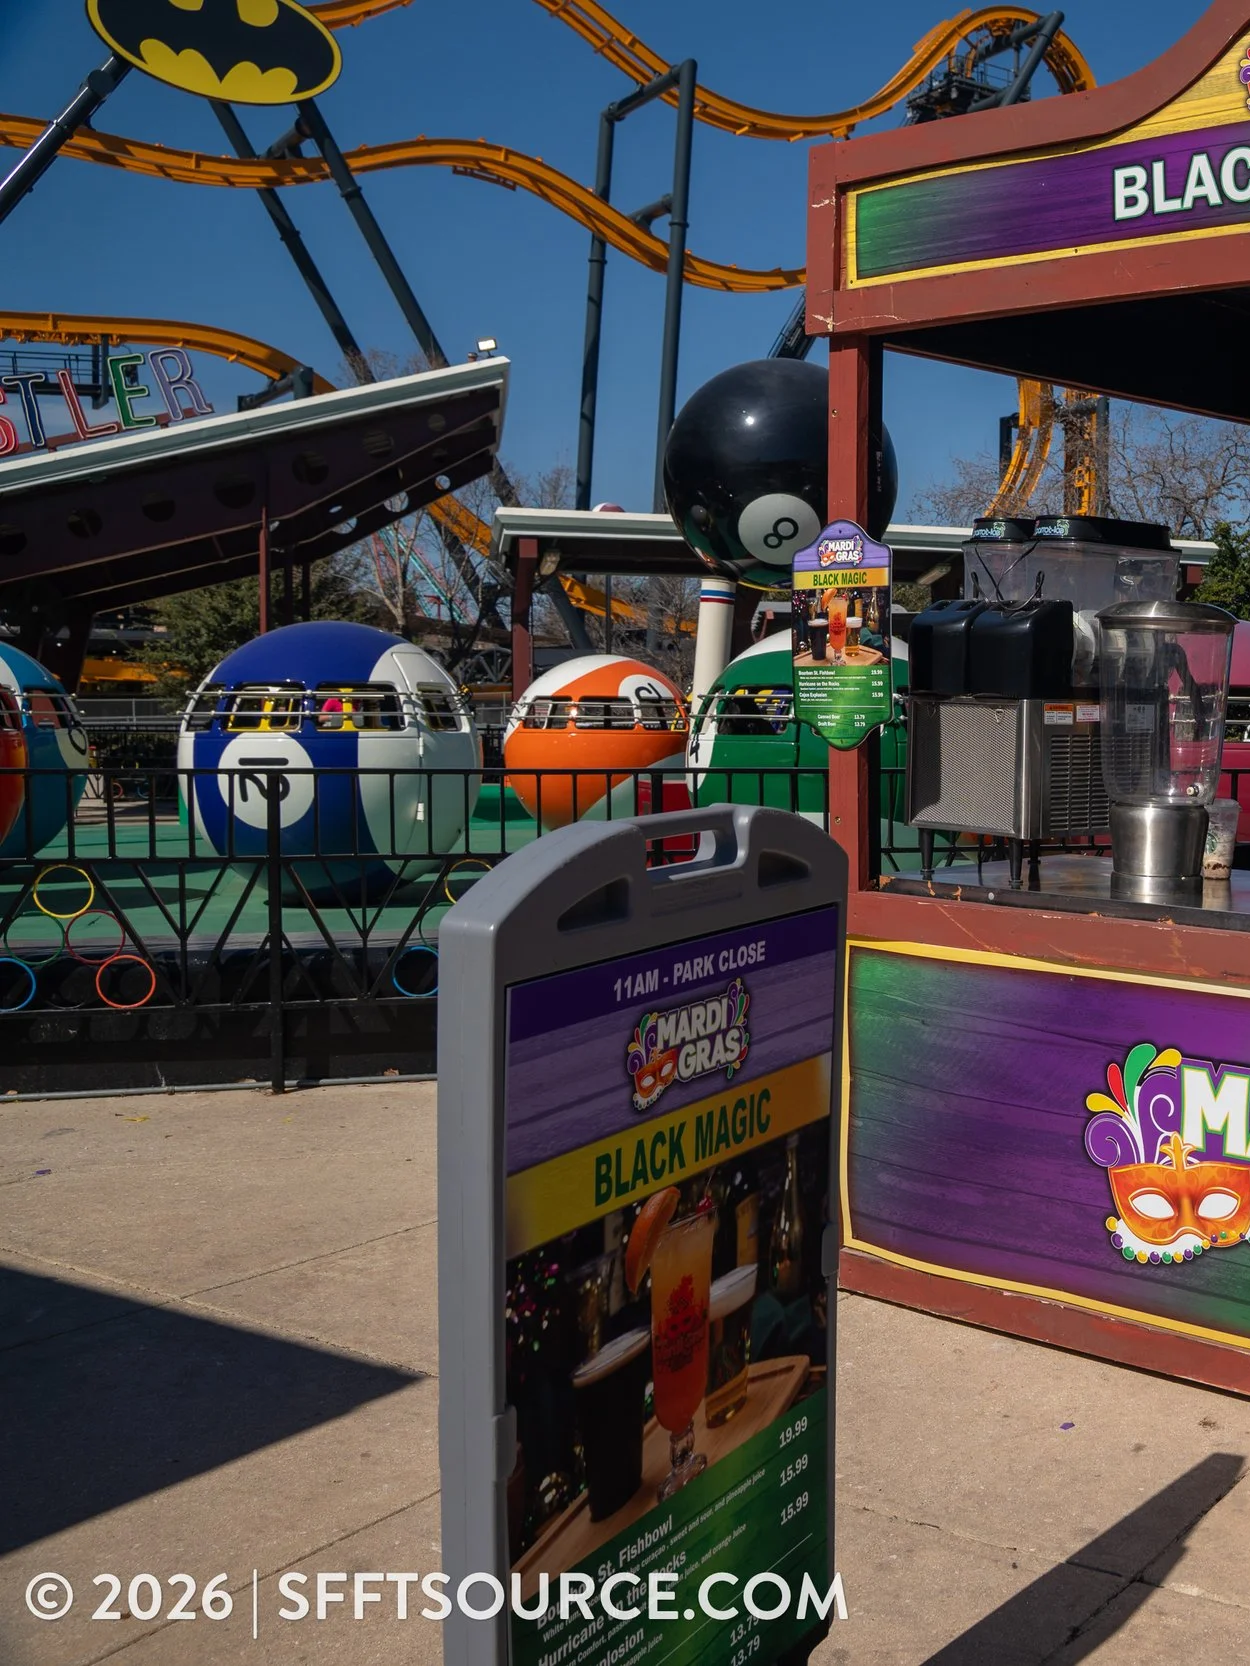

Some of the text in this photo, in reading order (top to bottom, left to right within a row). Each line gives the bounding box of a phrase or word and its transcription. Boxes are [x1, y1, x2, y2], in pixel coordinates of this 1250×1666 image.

[763, 517, 799, 549] 8
[828, 541, 855, 552] MARDI
[835, 551, 860, 562] GRAS
[813, 571, 868, 587] BLACK MAGIC
[613, 968, 660, 1002] 11AM
[673, 956, 715, 986] PARK
[718, 940, 766, 972] CLOSE
[657, 998, 728, 1049] MARDI
[678, 1029, 743, 1079] GRAS
[594, 1087, 771, 1207] BLACK MAGIC
[597, 1560, 617, 1585] St.
[618, 1513, 673, 1568] Fishbowl
[779, 1415, 808, 1449] 19.99
[780, 1491, 809, 1526] 15.99
[537, 1614, 606, 1666] Hurricane
[626, 1581, 648, 1607] the
[780, 1453, 809, 1487] 15.99
[542, 1620, 564, 1643] White
[669, 1525, 688, 1547] sweet
[688, 1517, 700, 1533] and
[714, 1497, 726, 1512] and
[725, 1479, 752, 1505] pineapple
[752, 1468, 766, 1486] juice
[577, 1633, 608, 1664] Comfort,
[701, 1549, 712, 1565] and
[712, 1535, 732, 1555] orange
[732, 1522, 748, 1541] juice
[649, 1631, 664, 1653] juice
[730, 1634, 760, 1666] 13.79
